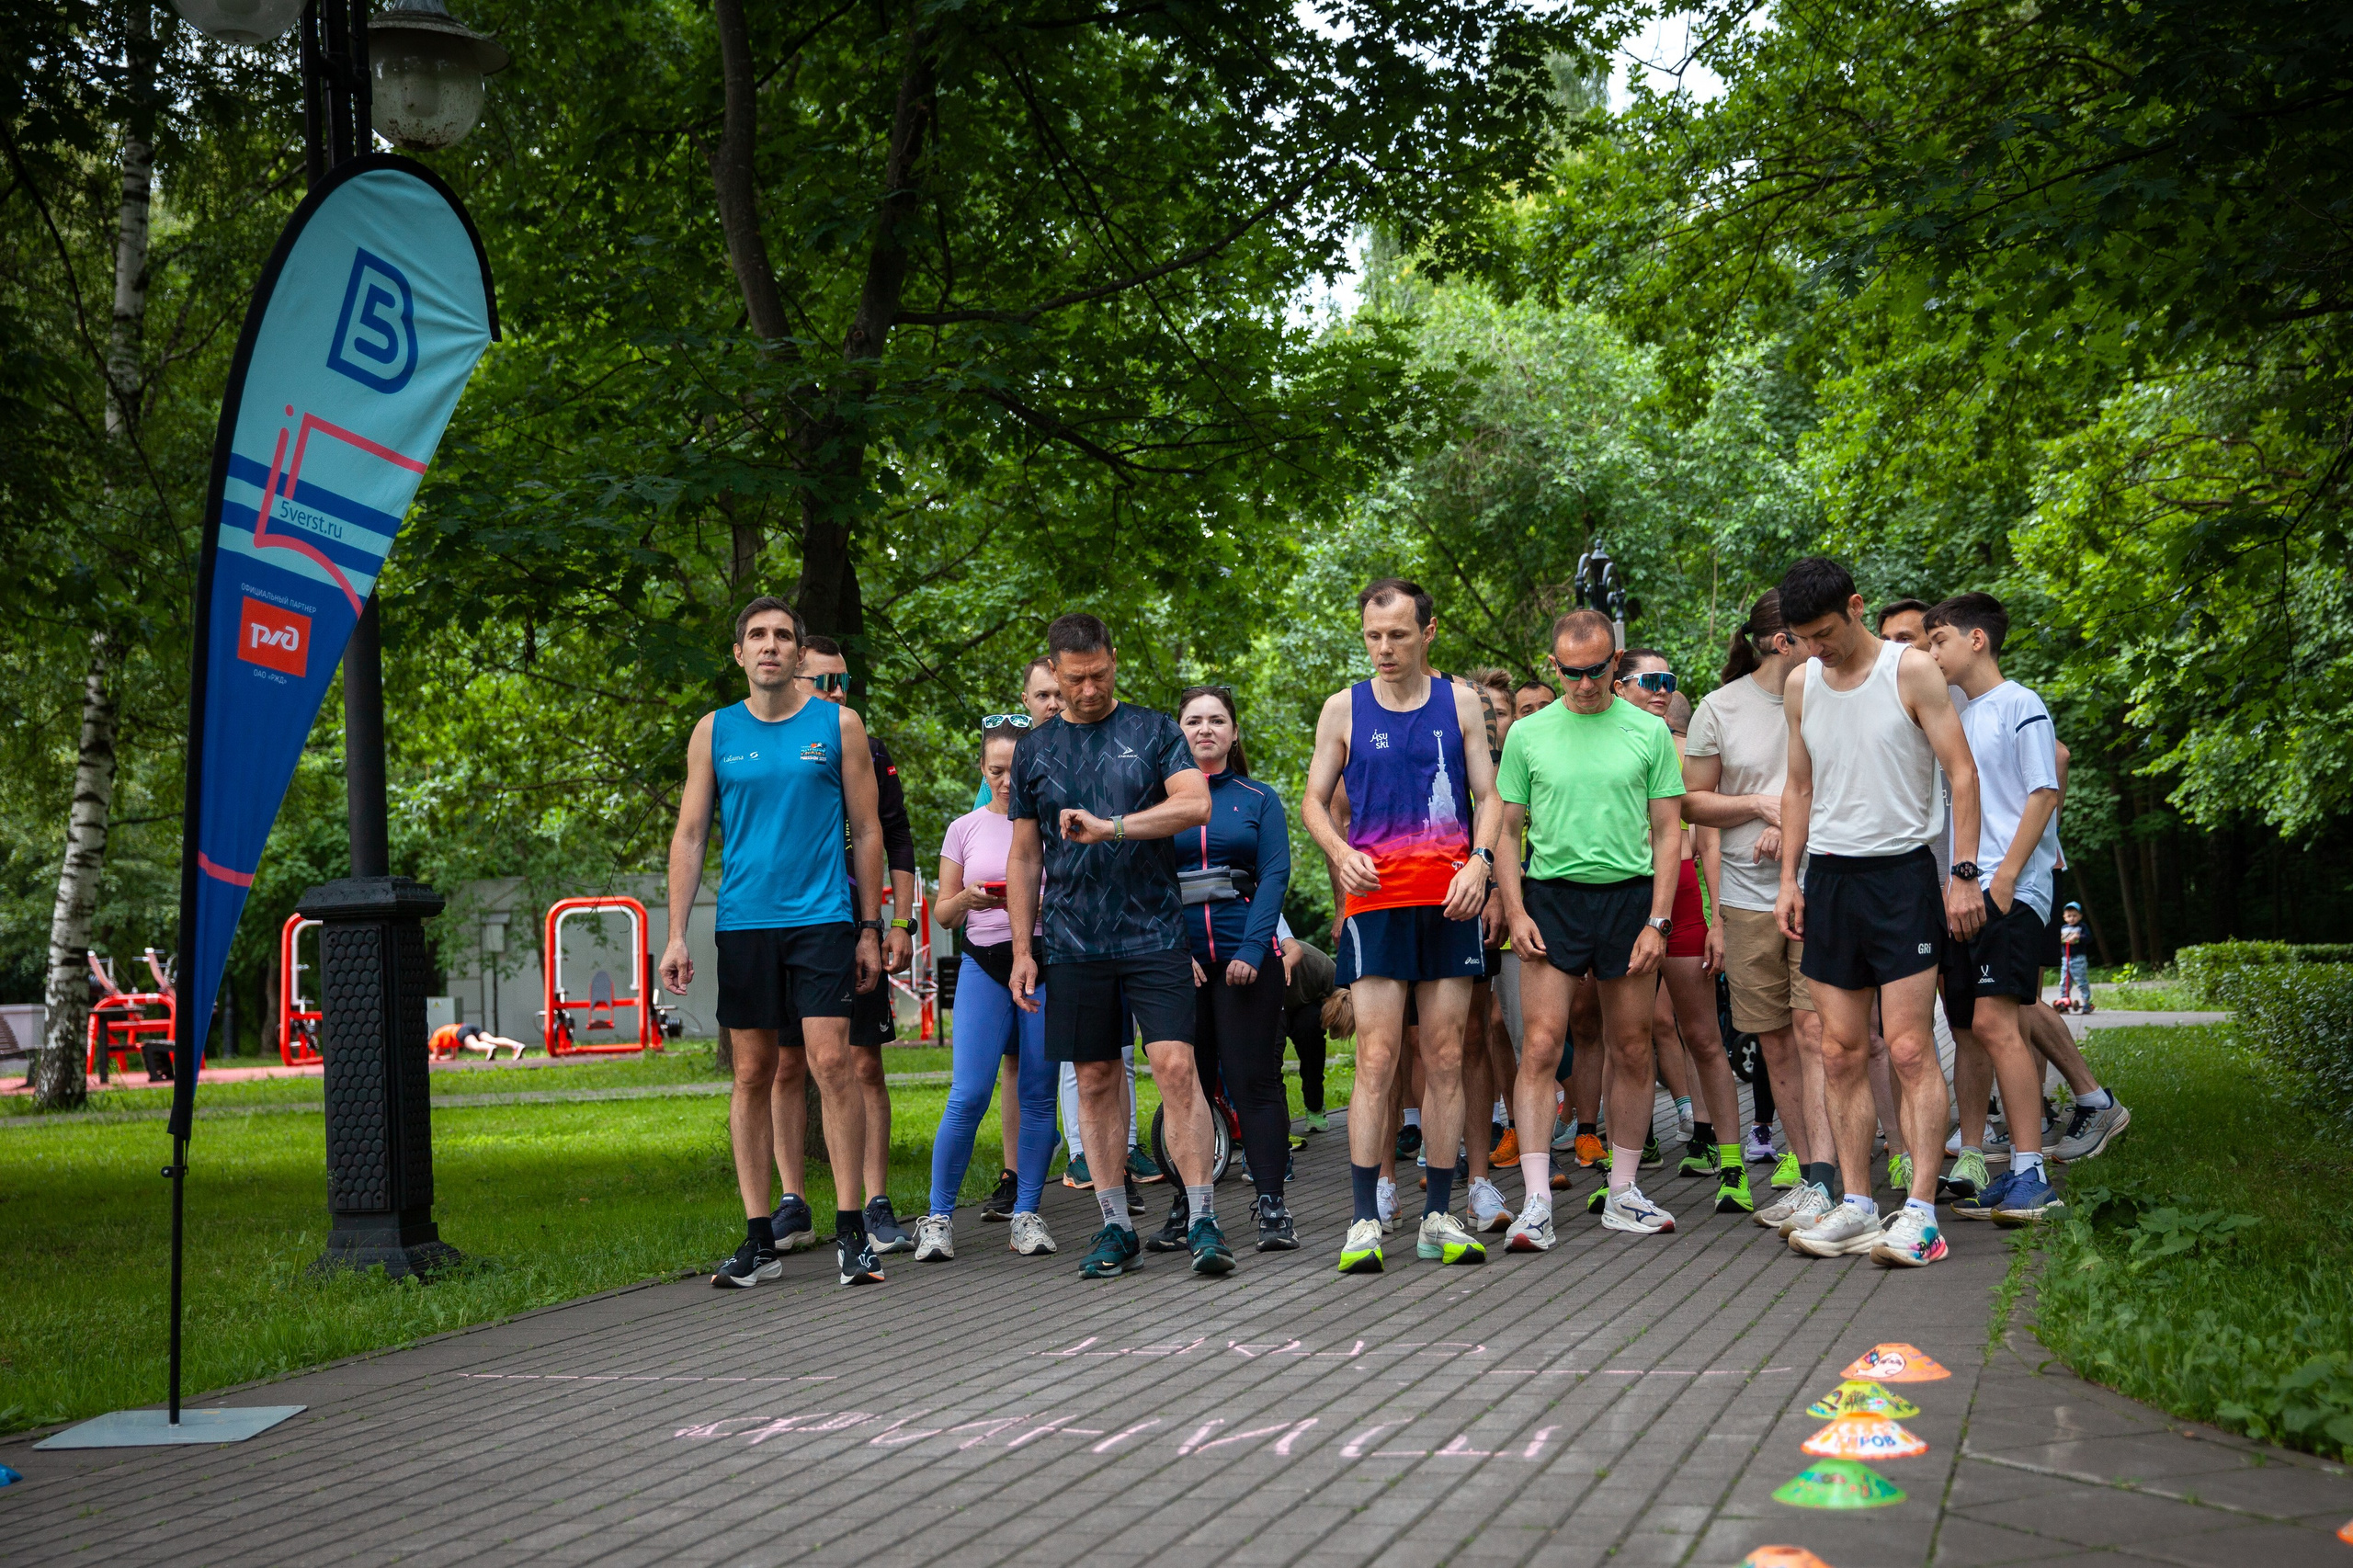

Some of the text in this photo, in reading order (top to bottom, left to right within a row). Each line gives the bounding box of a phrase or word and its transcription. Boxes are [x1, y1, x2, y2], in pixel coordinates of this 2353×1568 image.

[279, 500, 343, 539] 5verst.ru
[241, 583, 317, 614] ОФИЦИАЛЬНЫЙ ПАРТНЕР
[253, 668, 267, 679] ОАО
[1375, 739, 1390, 750] ski
[674, 1408, 1564, 1459] ФИНИШ
